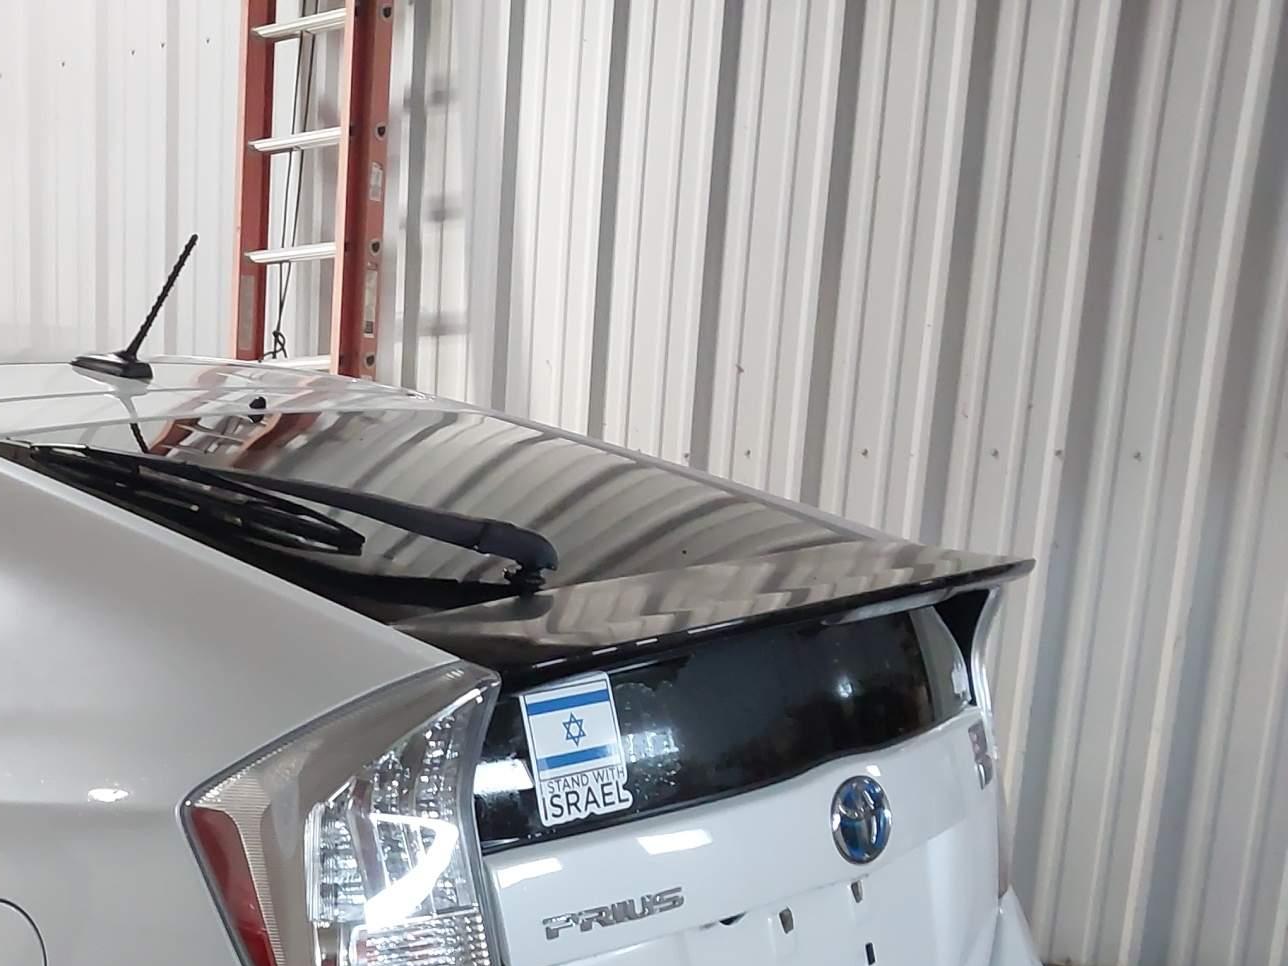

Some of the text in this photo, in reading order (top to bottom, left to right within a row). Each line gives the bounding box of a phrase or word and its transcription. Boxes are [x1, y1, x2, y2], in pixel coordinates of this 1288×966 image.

[542, 780, 630, 821] ISRAEL
[547, 773, 589, 794] STAND
[592, 766, 625, 784] WITH
[542, 886, 685, 941] PRIUS
